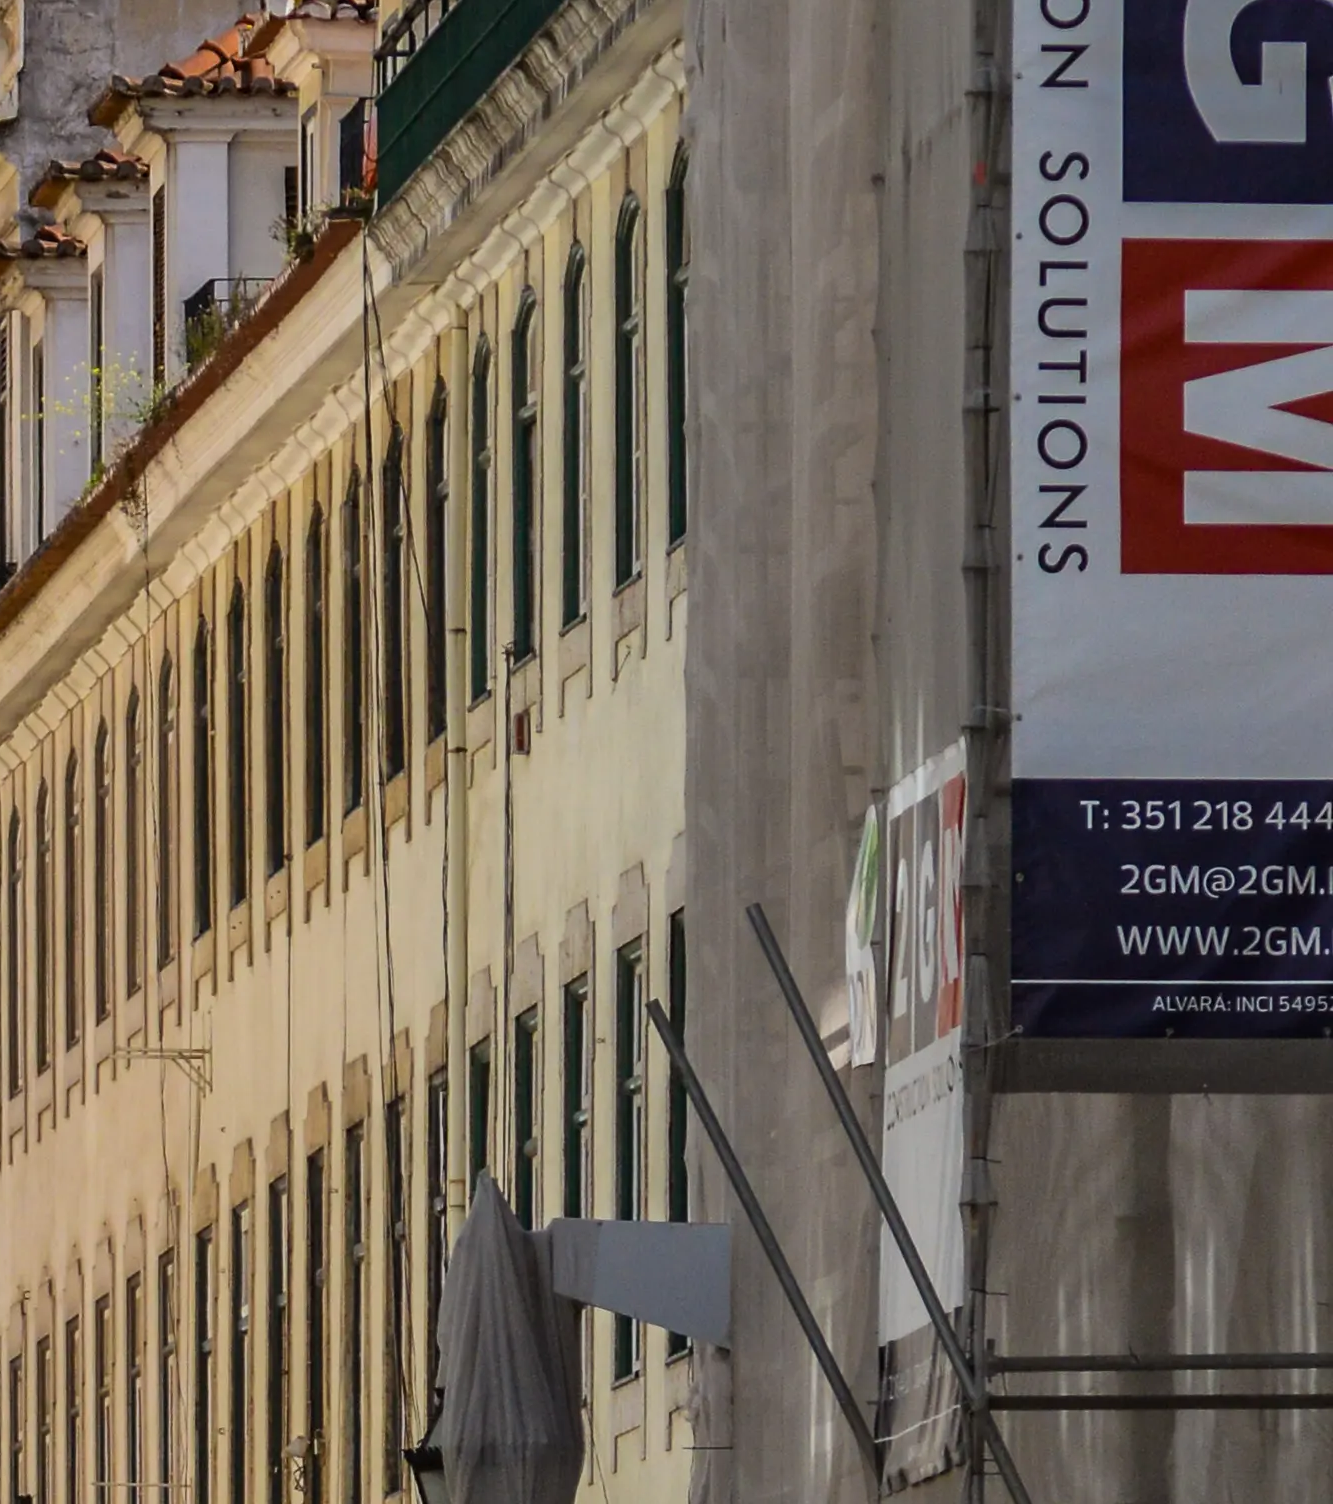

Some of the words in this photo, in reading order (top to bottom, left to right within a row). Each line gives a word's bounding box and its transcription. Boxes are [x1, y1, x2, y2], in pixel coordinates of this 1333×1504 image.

[1036, 151, 1090, 576] SOLUTIONS
[1080, 800, 1110, 830] T:
[1121, 800, 1182, 830] 351
[1192, 800, 1253, 830] 218
[1117, 925, 1333, 956] WWW.2GM.
[1152, 993, 1231, 1012] ALVARÁ:
[1236, 996, 1273, 1012] INCI
